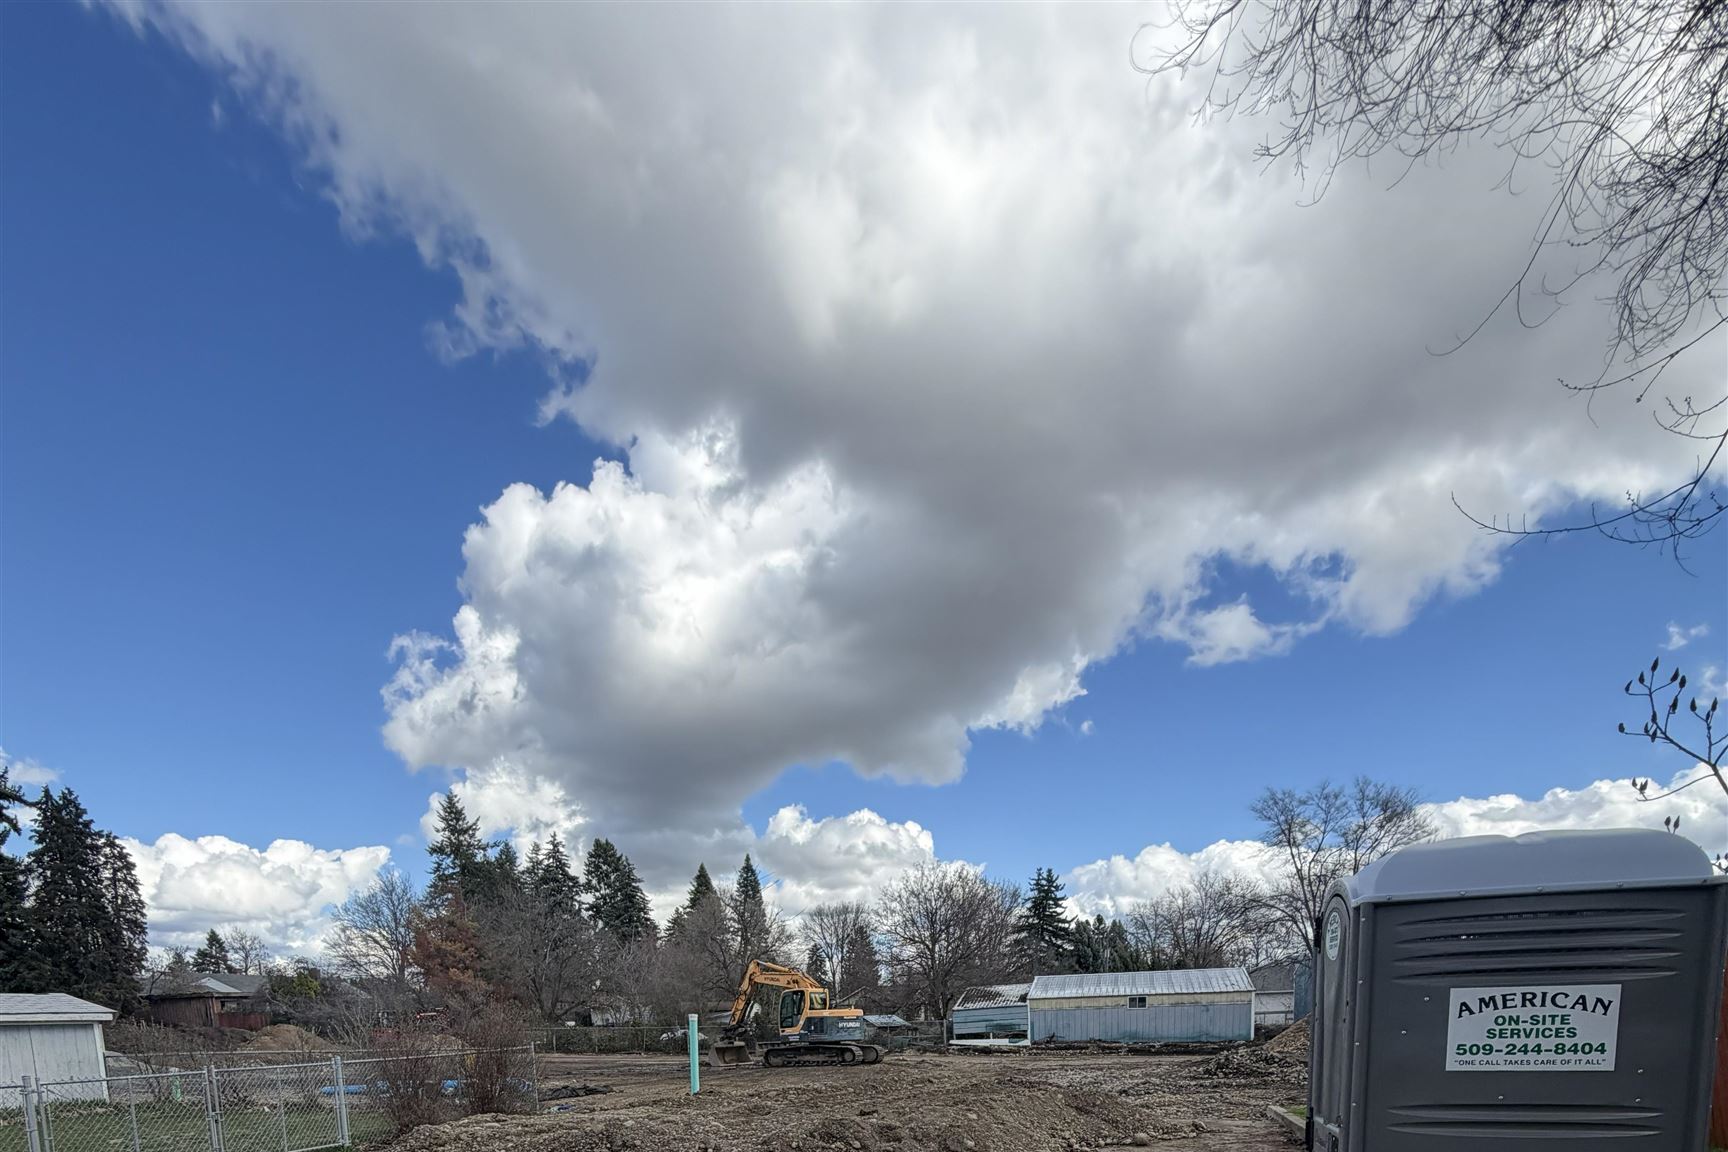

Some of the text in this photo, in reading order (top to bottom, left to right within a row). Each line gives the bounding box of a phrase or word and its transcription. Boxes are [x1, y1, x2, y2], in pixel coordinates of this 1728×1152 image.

[1457, 991, 1613, 1019] AMERICAN
[1494, 1014, 1571, 1026] ON-SITE
[1486, 1027, 1577, 1039] SERVICES
[1455, 1042, 1607, 1056] 509-244-8404
